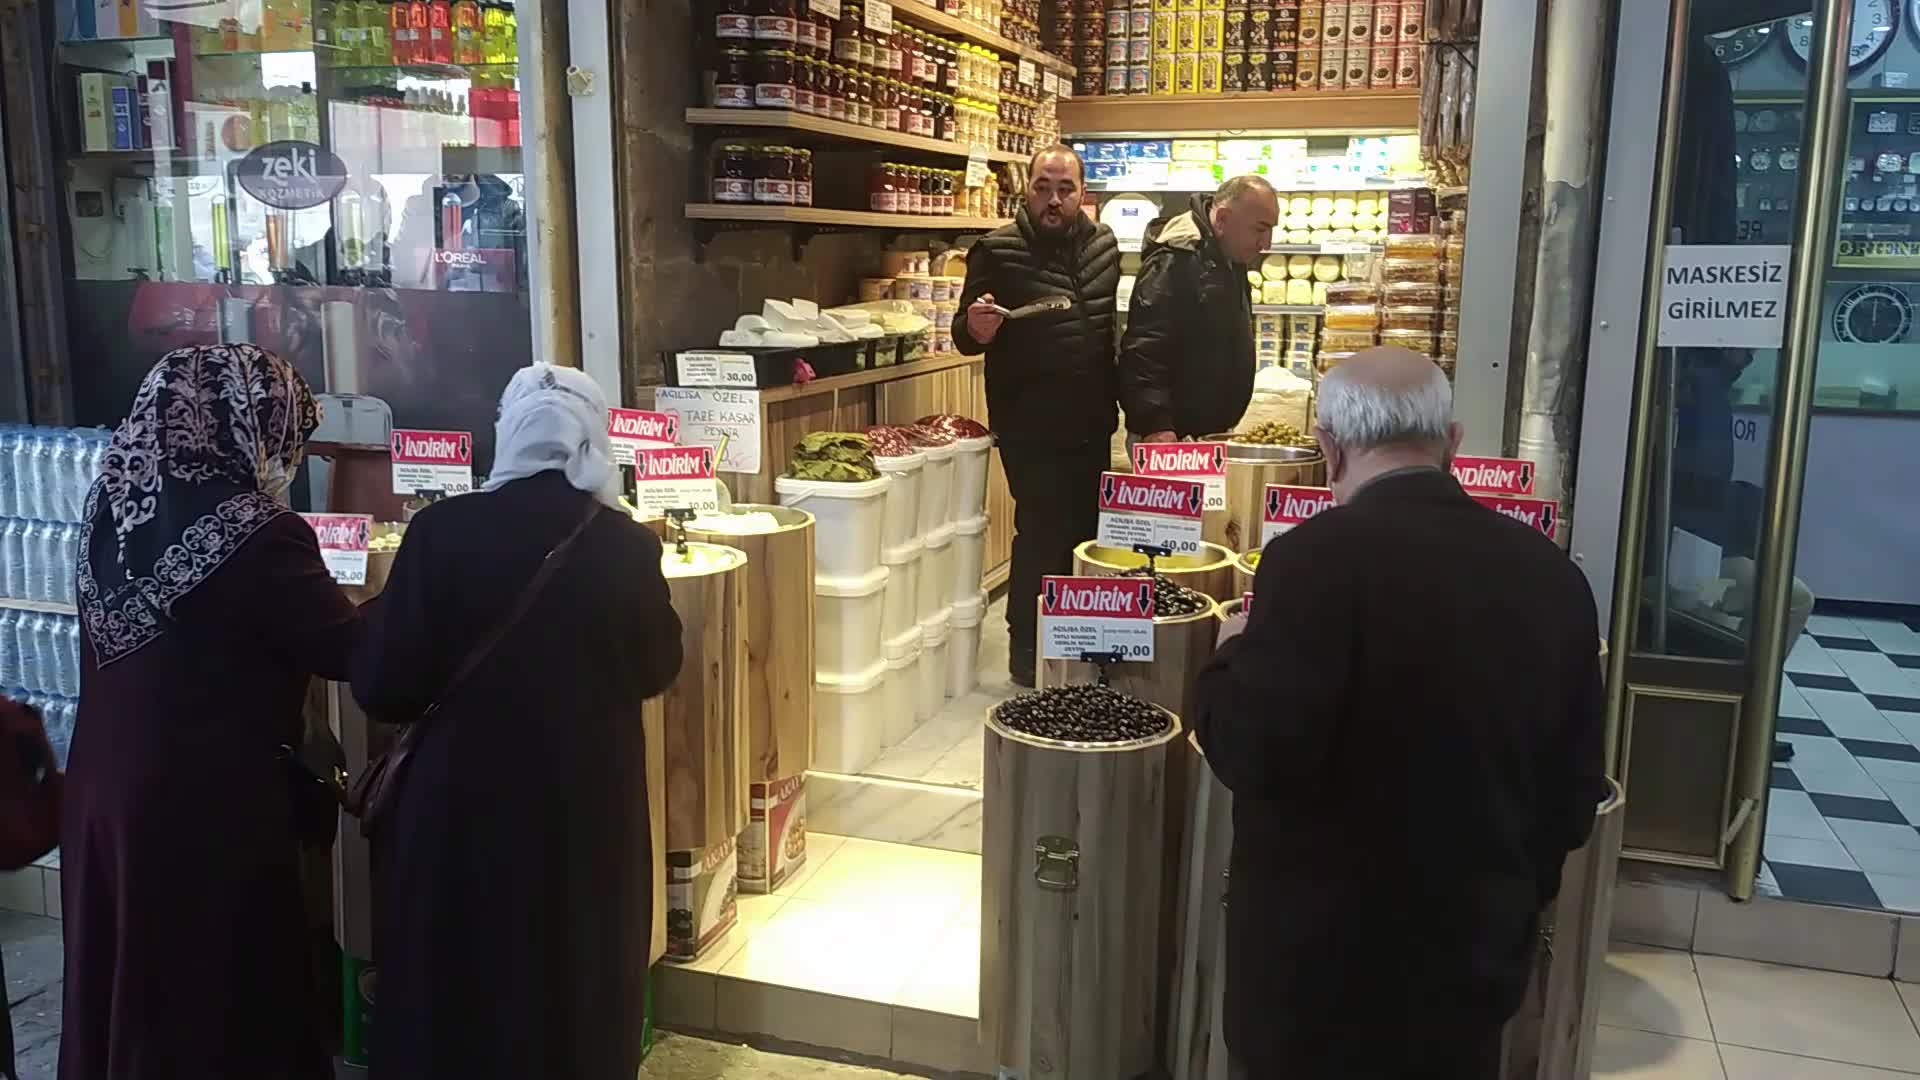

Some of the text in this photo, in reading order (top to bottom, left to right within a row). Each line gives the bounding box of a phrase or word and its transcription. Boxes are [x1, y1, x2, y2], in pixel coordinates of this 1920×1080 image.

[1872, 13, 1883, 25] 3
[1714, 44, 1726, 57] 6
[1734, 39, 1744, 52] 5
[261, 147, 318, 186] zeki
[1666, 261, 1782, 284] MASKESİZ
[1668, 298, 1777, 320] GİRİLMEZ
[727, 372, 754, 383] 30,00
[613, 413, 665, 437] İNDİRİM
[405, 435, 457, 459] İNDİRİM
[648, 452, 700, 476] İNDİRİM
[1149, 448, 1211, 471] İNDİRİM
[1117, 480, 1185, 510] İNDİRİM
[1161, 540, 1198, 552] 40,00
[1060, 583, 1134, 612] İNDİRİM
[1111, 644, 1151, 657] 20,00
